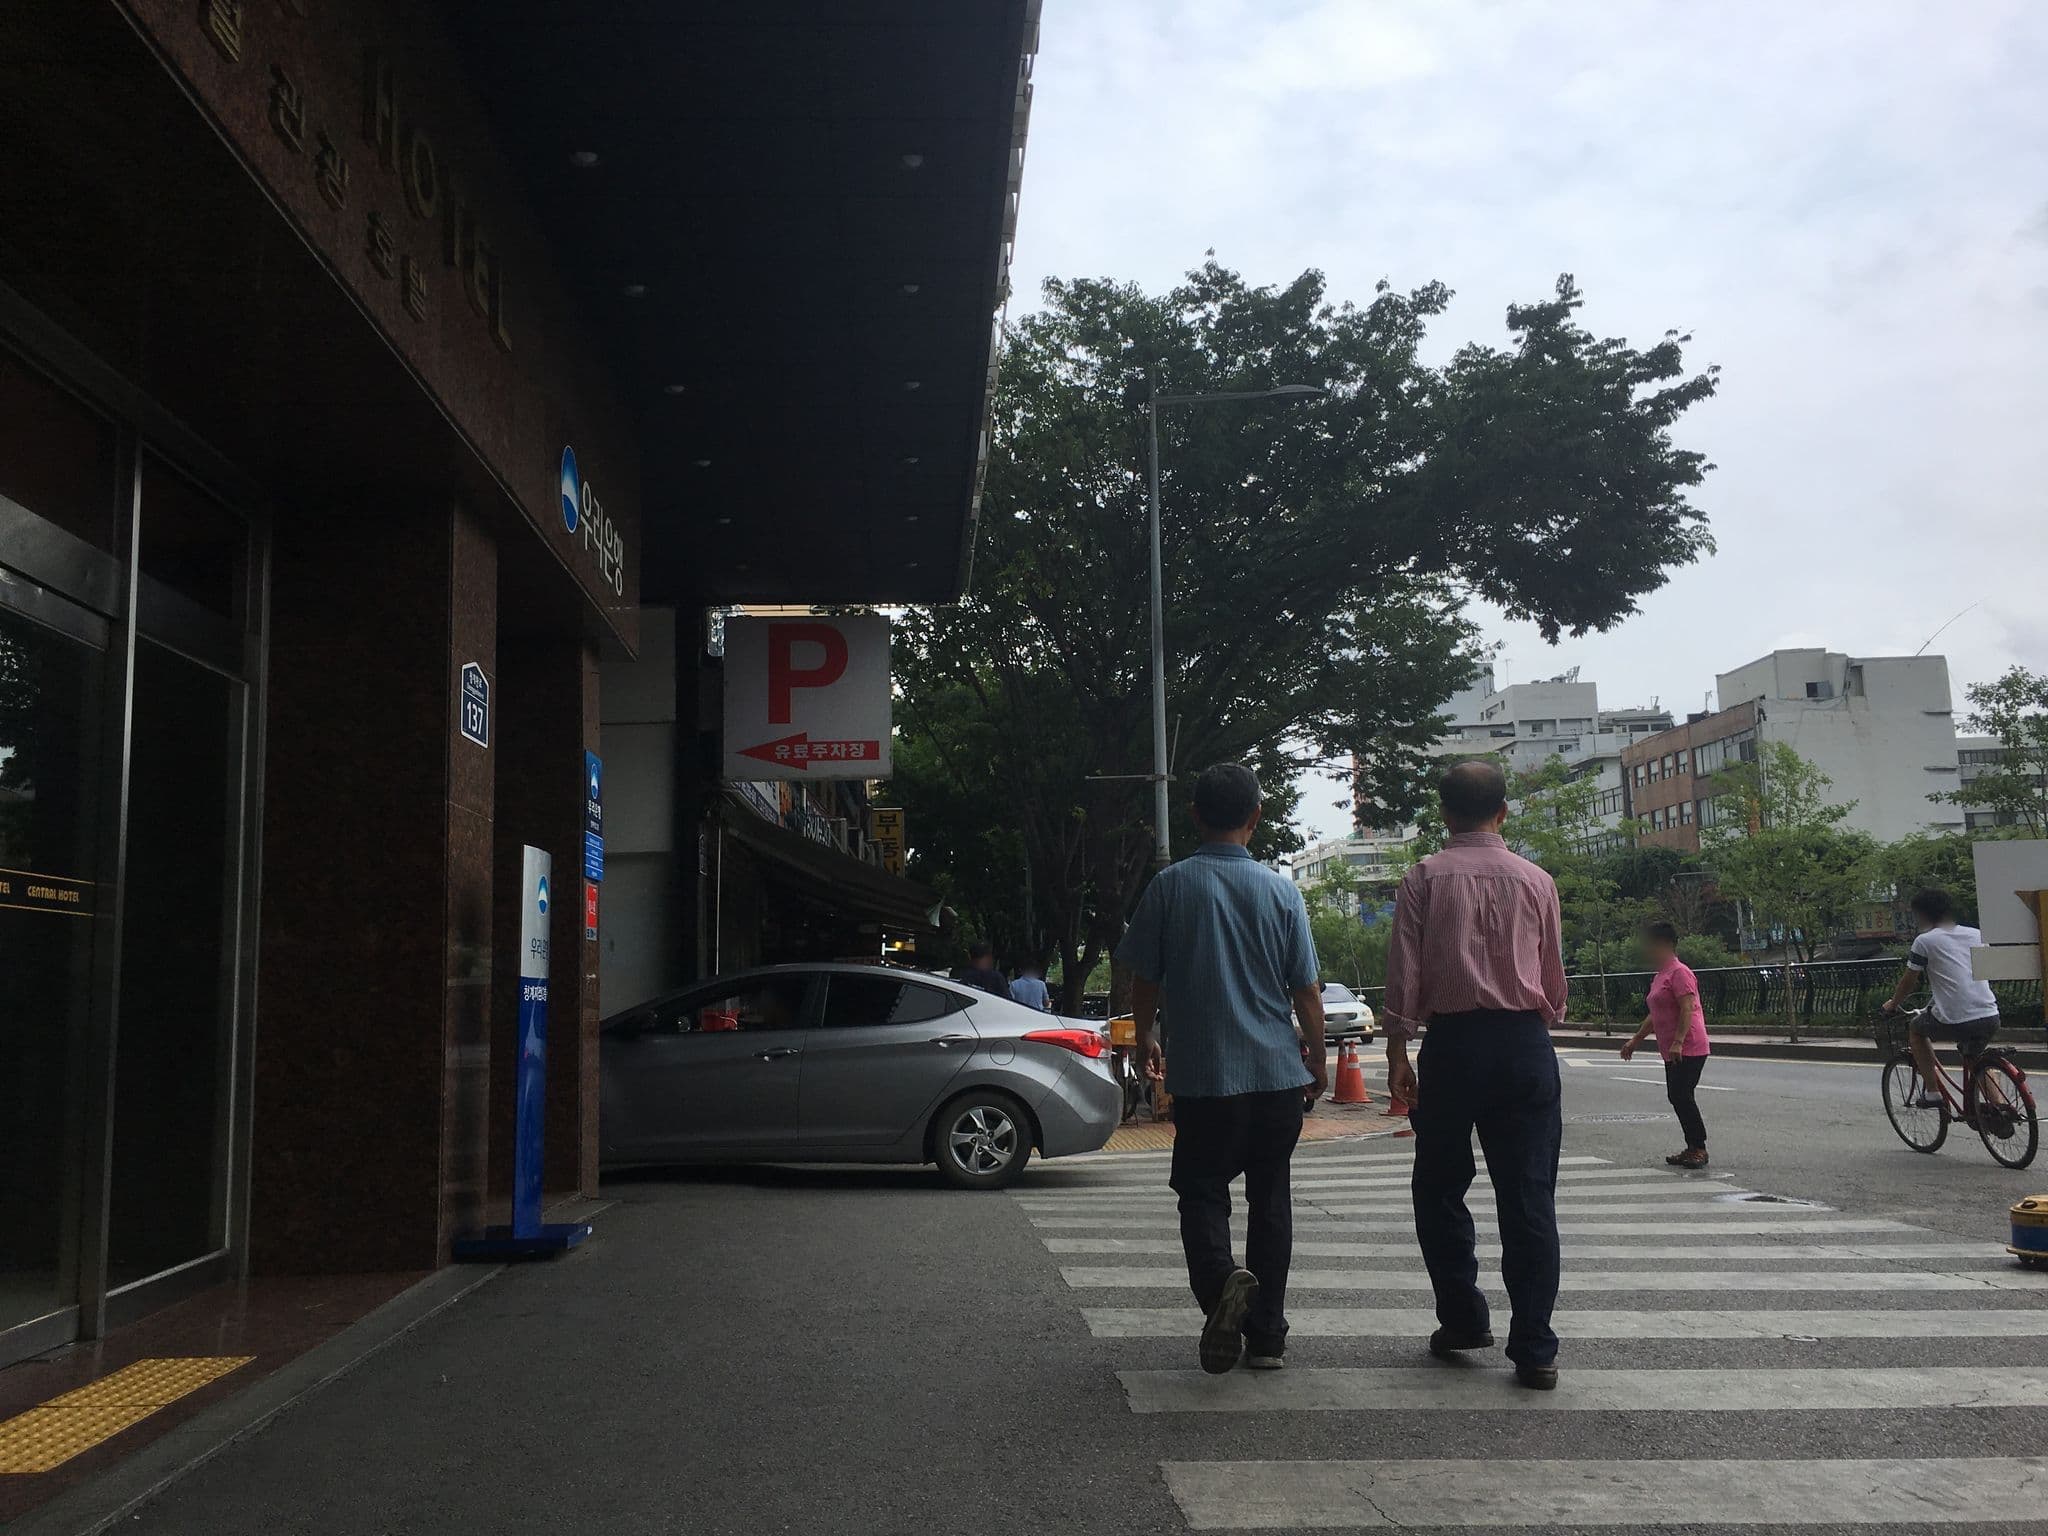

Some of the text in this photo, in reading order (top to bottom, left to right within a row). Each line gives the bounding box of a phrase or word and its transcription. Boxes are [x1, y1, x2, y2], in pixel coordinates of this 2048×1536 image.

[580, 480, 624, 597] 우리은행
[768, 623, 849, 724] P
[466, 701, 484, 735] 137
[774, 743, 866, 760] 유료주차장
